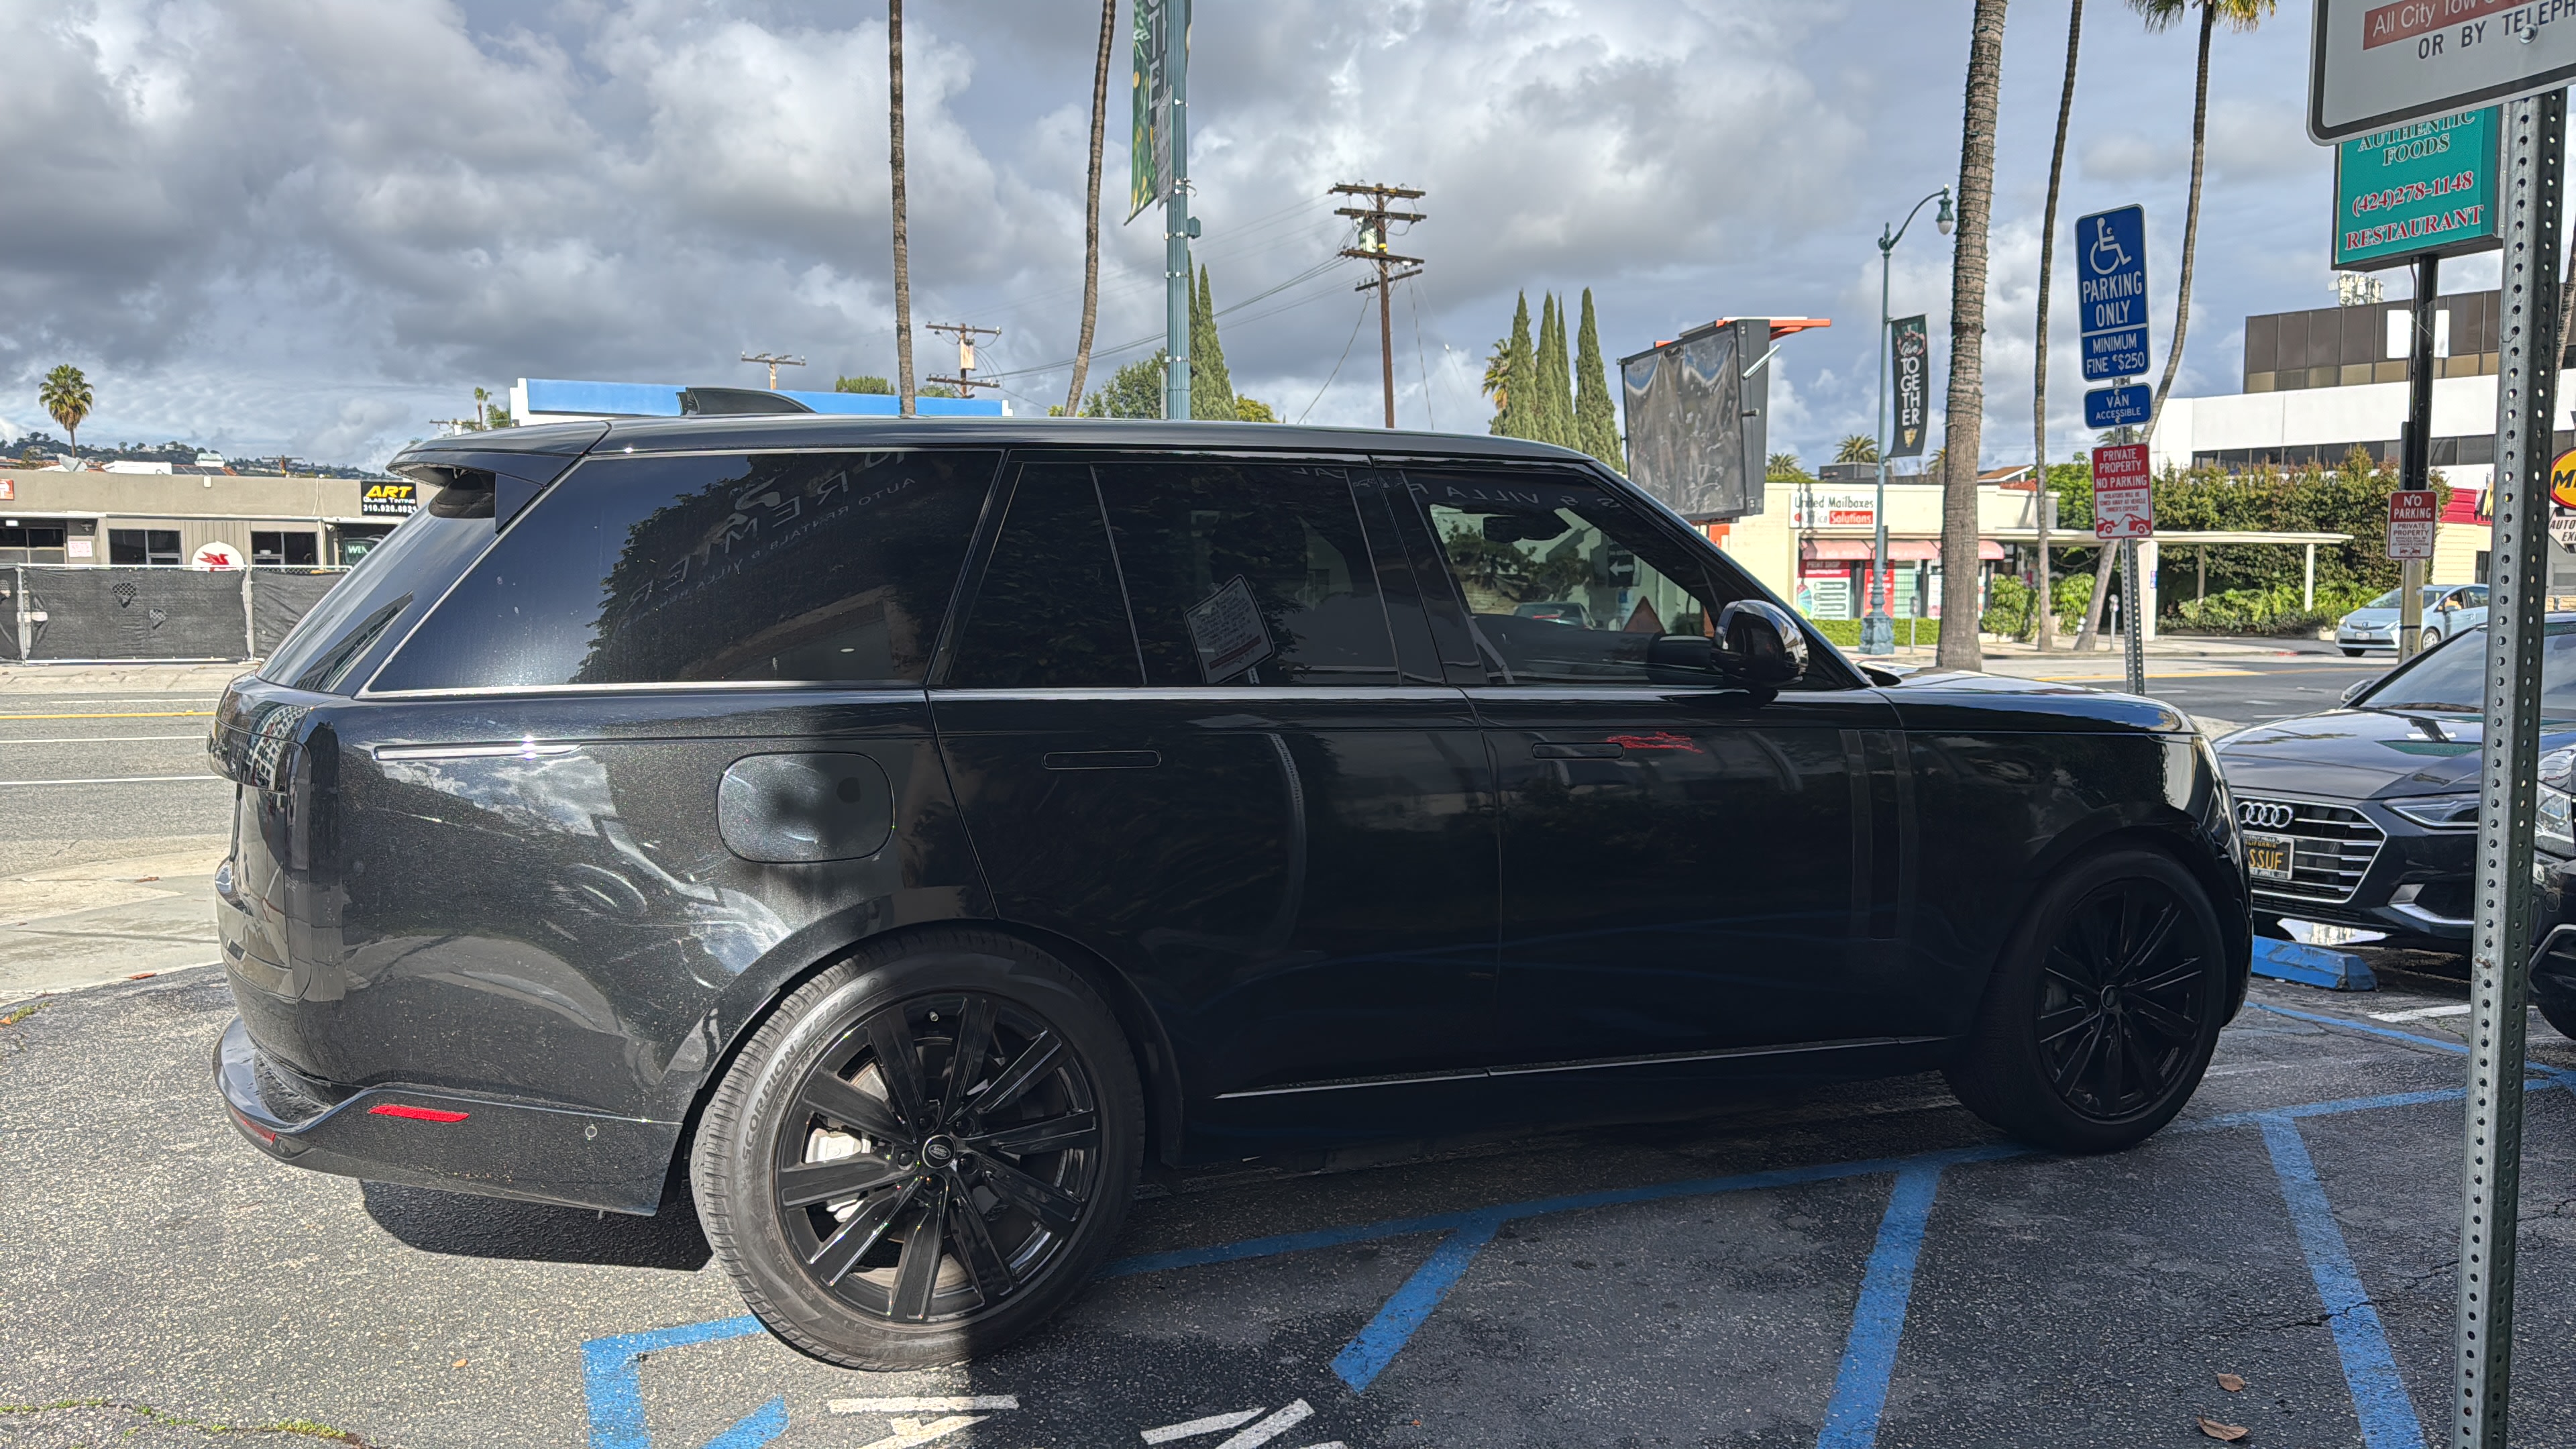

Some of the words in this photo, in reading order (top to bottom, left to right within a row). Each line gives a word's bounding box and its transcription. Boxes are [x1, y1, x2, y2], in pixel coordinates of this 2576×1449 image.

[2373, 13, 2395, 38] All
[2401, 3, 2436, 28] City
[2418, 34, 2444, 60] OR
[2461, 21, 2487, 48] BY
[2358, 110, 2475, 152] AUTHENTIC
[2383, 133, 2450, 166] FOODS
[2352, 170, 2473, 218] (424)278-1148
[2345, 205, 2484, 251] RESTAURANT
[2082, 270, 2143, 304] PARKING
[2096, 299, 2131, 328] ONLY
[2092, 332, 2137, 354] MINIMUM
[1900, 357, 1920, 375] TO
[2086, 356, 2109, 375] FINE
[2118, 351, 2145, 372] $250
[1900, 374, 1921, 392] GE
[1901, 391, 1921, 409] TH
[2106, 394, 2129, 409] VAN
[1902, 408, 1921, 427] ER
[2095, 407, 2141, 421] ACCESSIBLE
[2102, 447, 2137, 462] PRIVATE
[2098, 460, 2142, 474] PROPERTY
[2096, 477, 2108, 489] NO
[2110, 474, 2147, 488] PARKING
[2552, 469, 2576, 490] M
[366, 485, 413, 498] ART
[1828, 496, 1874, 508] Mailboxes
[2404, 495, 2422, 507] NO
[1830, 511, 1872, 523] Solutions
[2394, 507, 2432, 519] PARKING
[2550, 519, 2576, 530] AUTO
[742, 1044, 798, 1161] SCORPION
